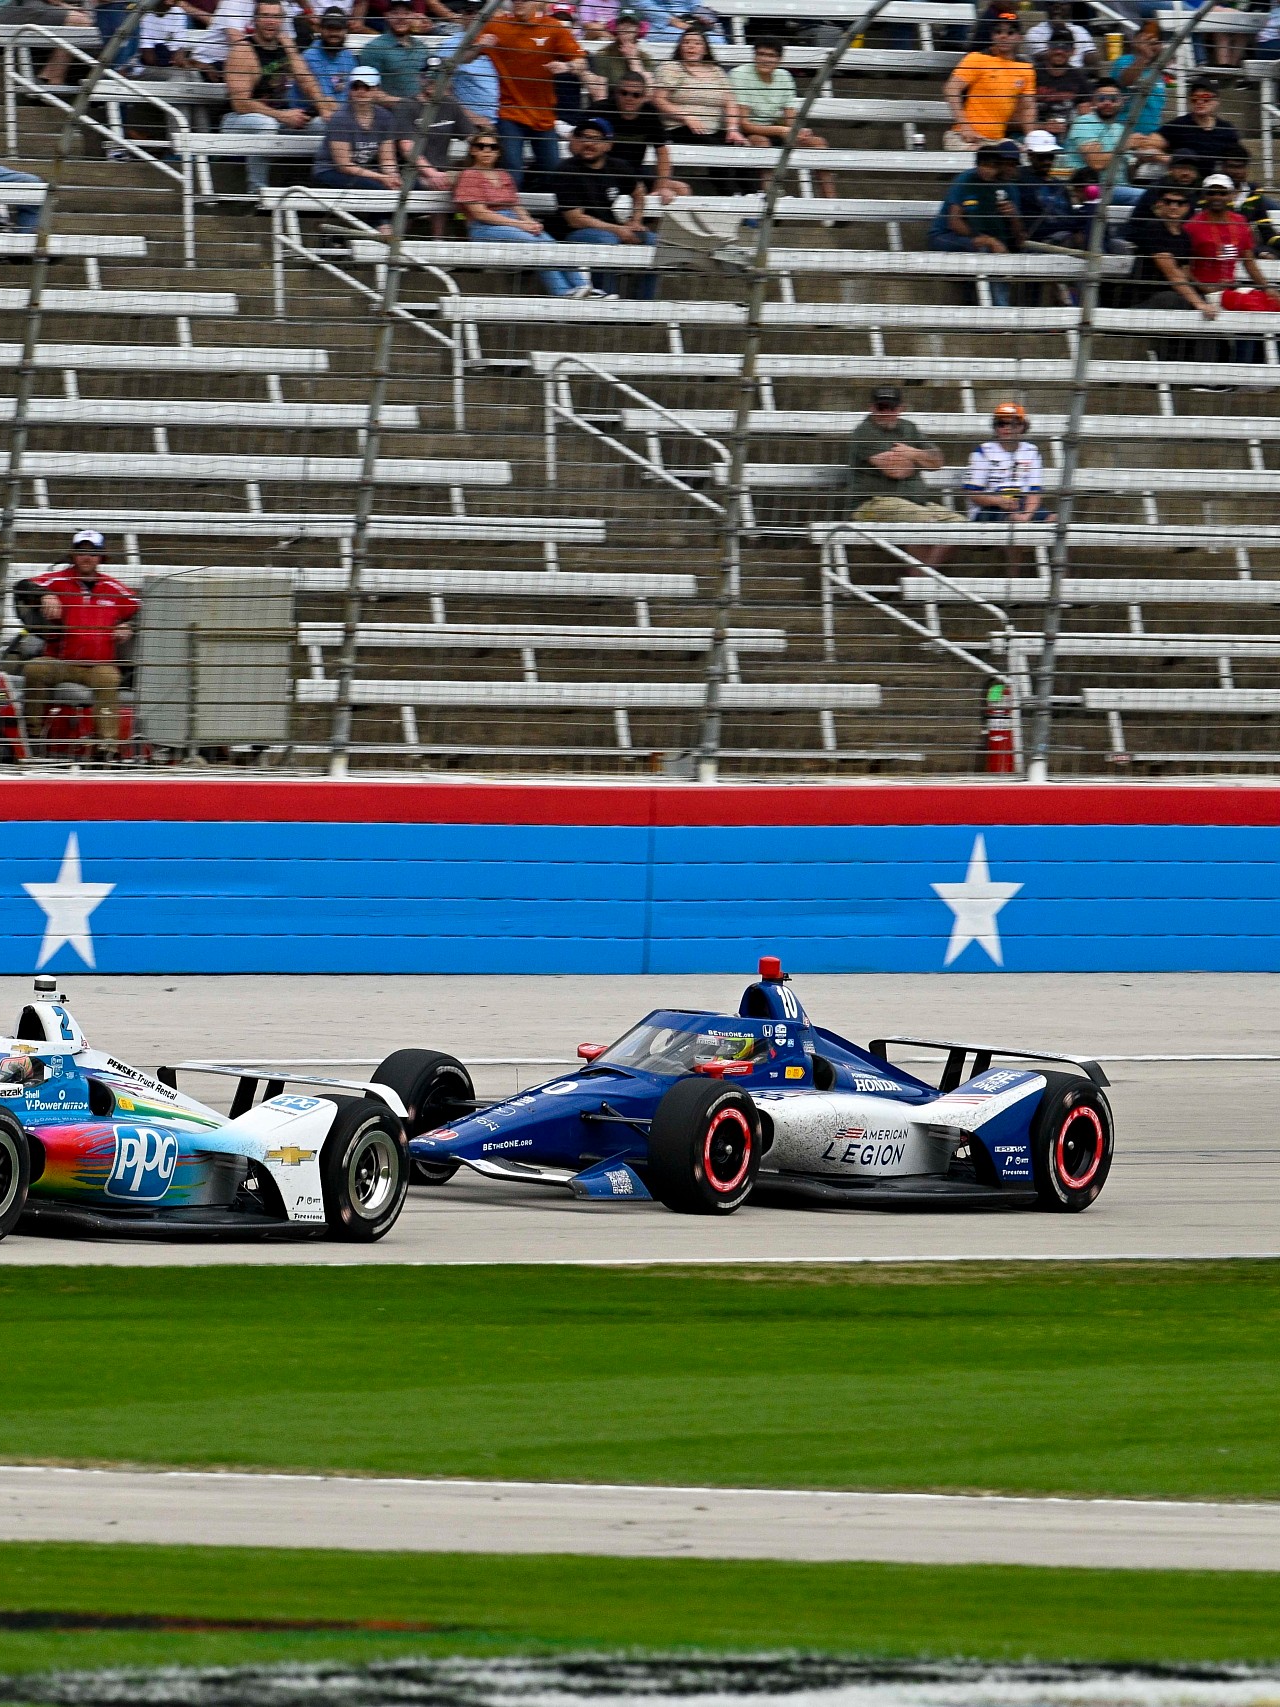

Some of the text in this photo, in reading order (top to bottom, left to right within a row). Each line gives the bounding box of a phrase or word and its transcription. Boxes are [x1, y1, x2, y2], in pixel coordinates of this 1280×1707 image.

[776, 985, 798, 1019] 10
[51, 1005, 74, 1041] 2
[107, 1057, 178, 1101] PENSKE Truck Rental
[853, 1078, 903, 1092] HONDA
[25, 1089, 40, 1099] Shell
[25, 1099, 62, 1111] V-Power
[861, 1128, 909, 1140] AMERICAN
[114, 1128, 175, 1192] PPG
[821, 1141, 906, 1166] LEGION
[293, 1212, 323, 1220] Firestone
